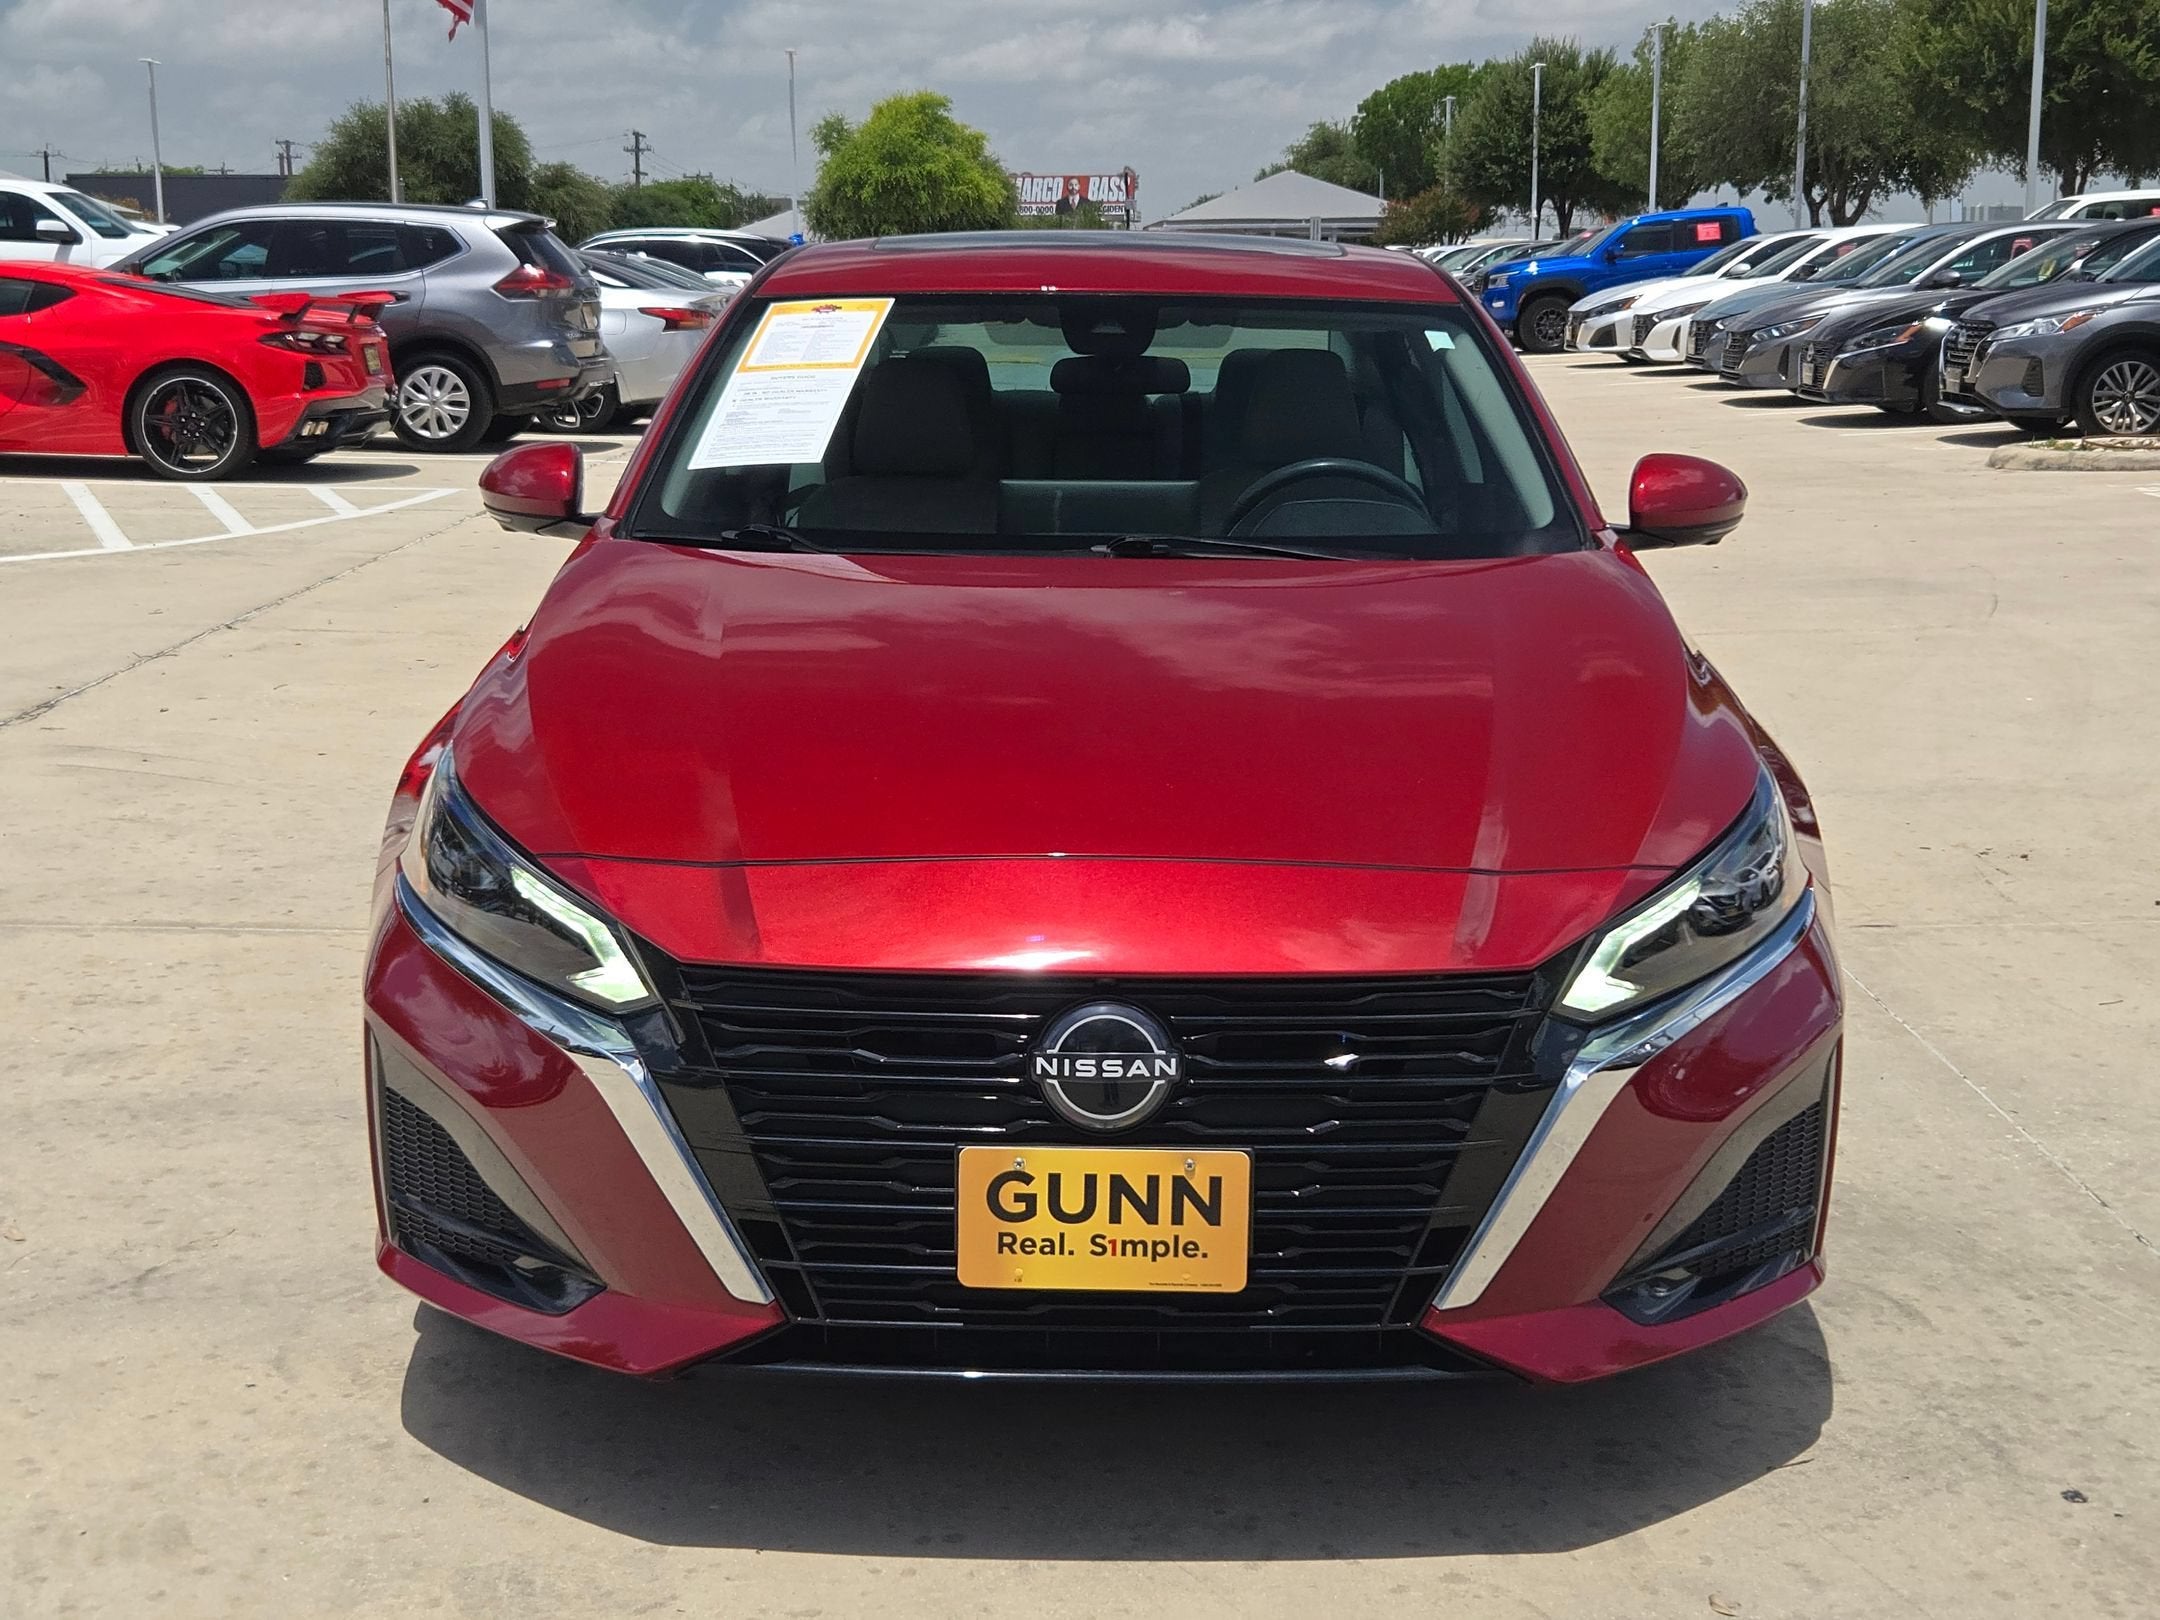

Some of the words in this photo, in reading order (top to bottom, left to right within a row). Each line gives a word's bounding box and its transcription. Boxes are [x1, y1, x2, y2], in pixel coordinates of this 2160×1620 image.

[1088, 176, 1130, 202] BASS
[1035, 1056, 1177, 1078] NISSAN
[986, 1169, 1222, 1227] GUNN
[997, 1231, 1075, 1256] Real.
[1089, 1232, 1209, 1262] S1mple.
